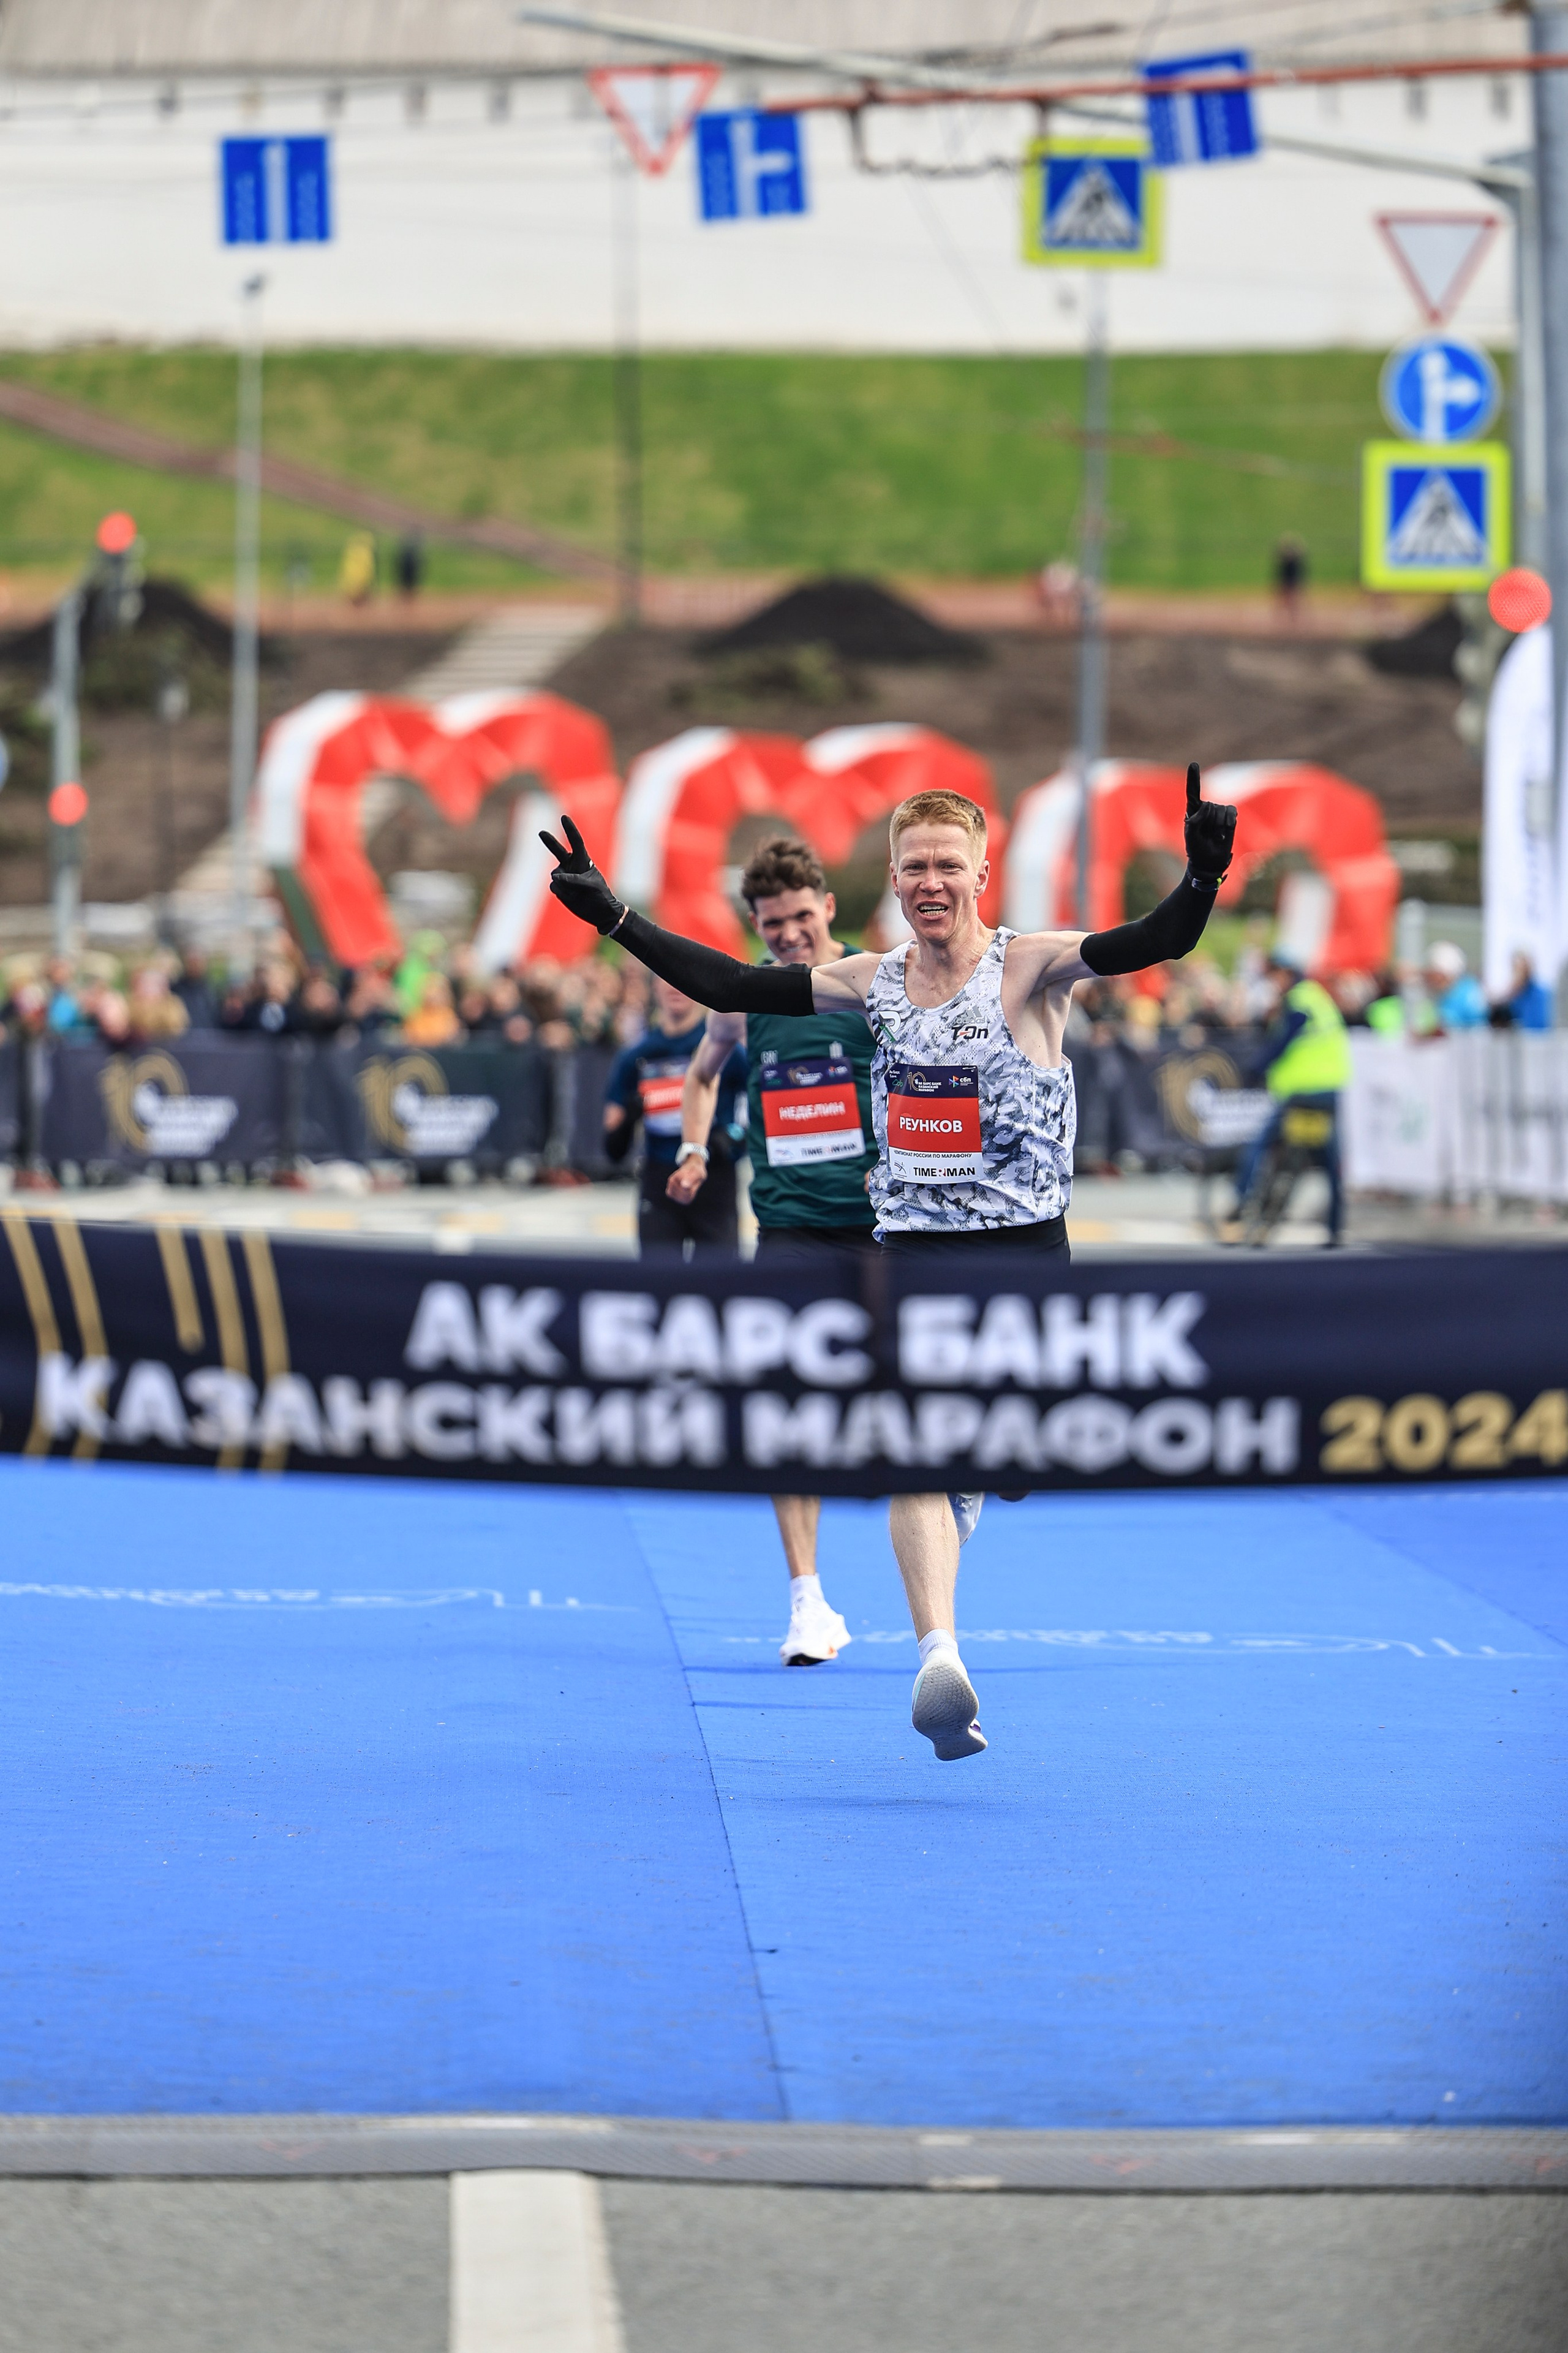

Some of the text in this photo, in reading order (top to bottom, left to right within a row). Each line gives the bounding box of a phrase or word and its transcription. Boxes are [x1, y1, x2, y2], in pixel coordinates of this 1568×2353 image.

[778, 1101, 846, 1121] НЕДЕЛИН
[899, 1116, 963, 1133] РЕУНКОВ
[404, 1280, 1210, 1391] АК БАРС БАНК
[36, 1350, 1568, 1475] КАЗАНСКИЙ МАРАФОН 2024
